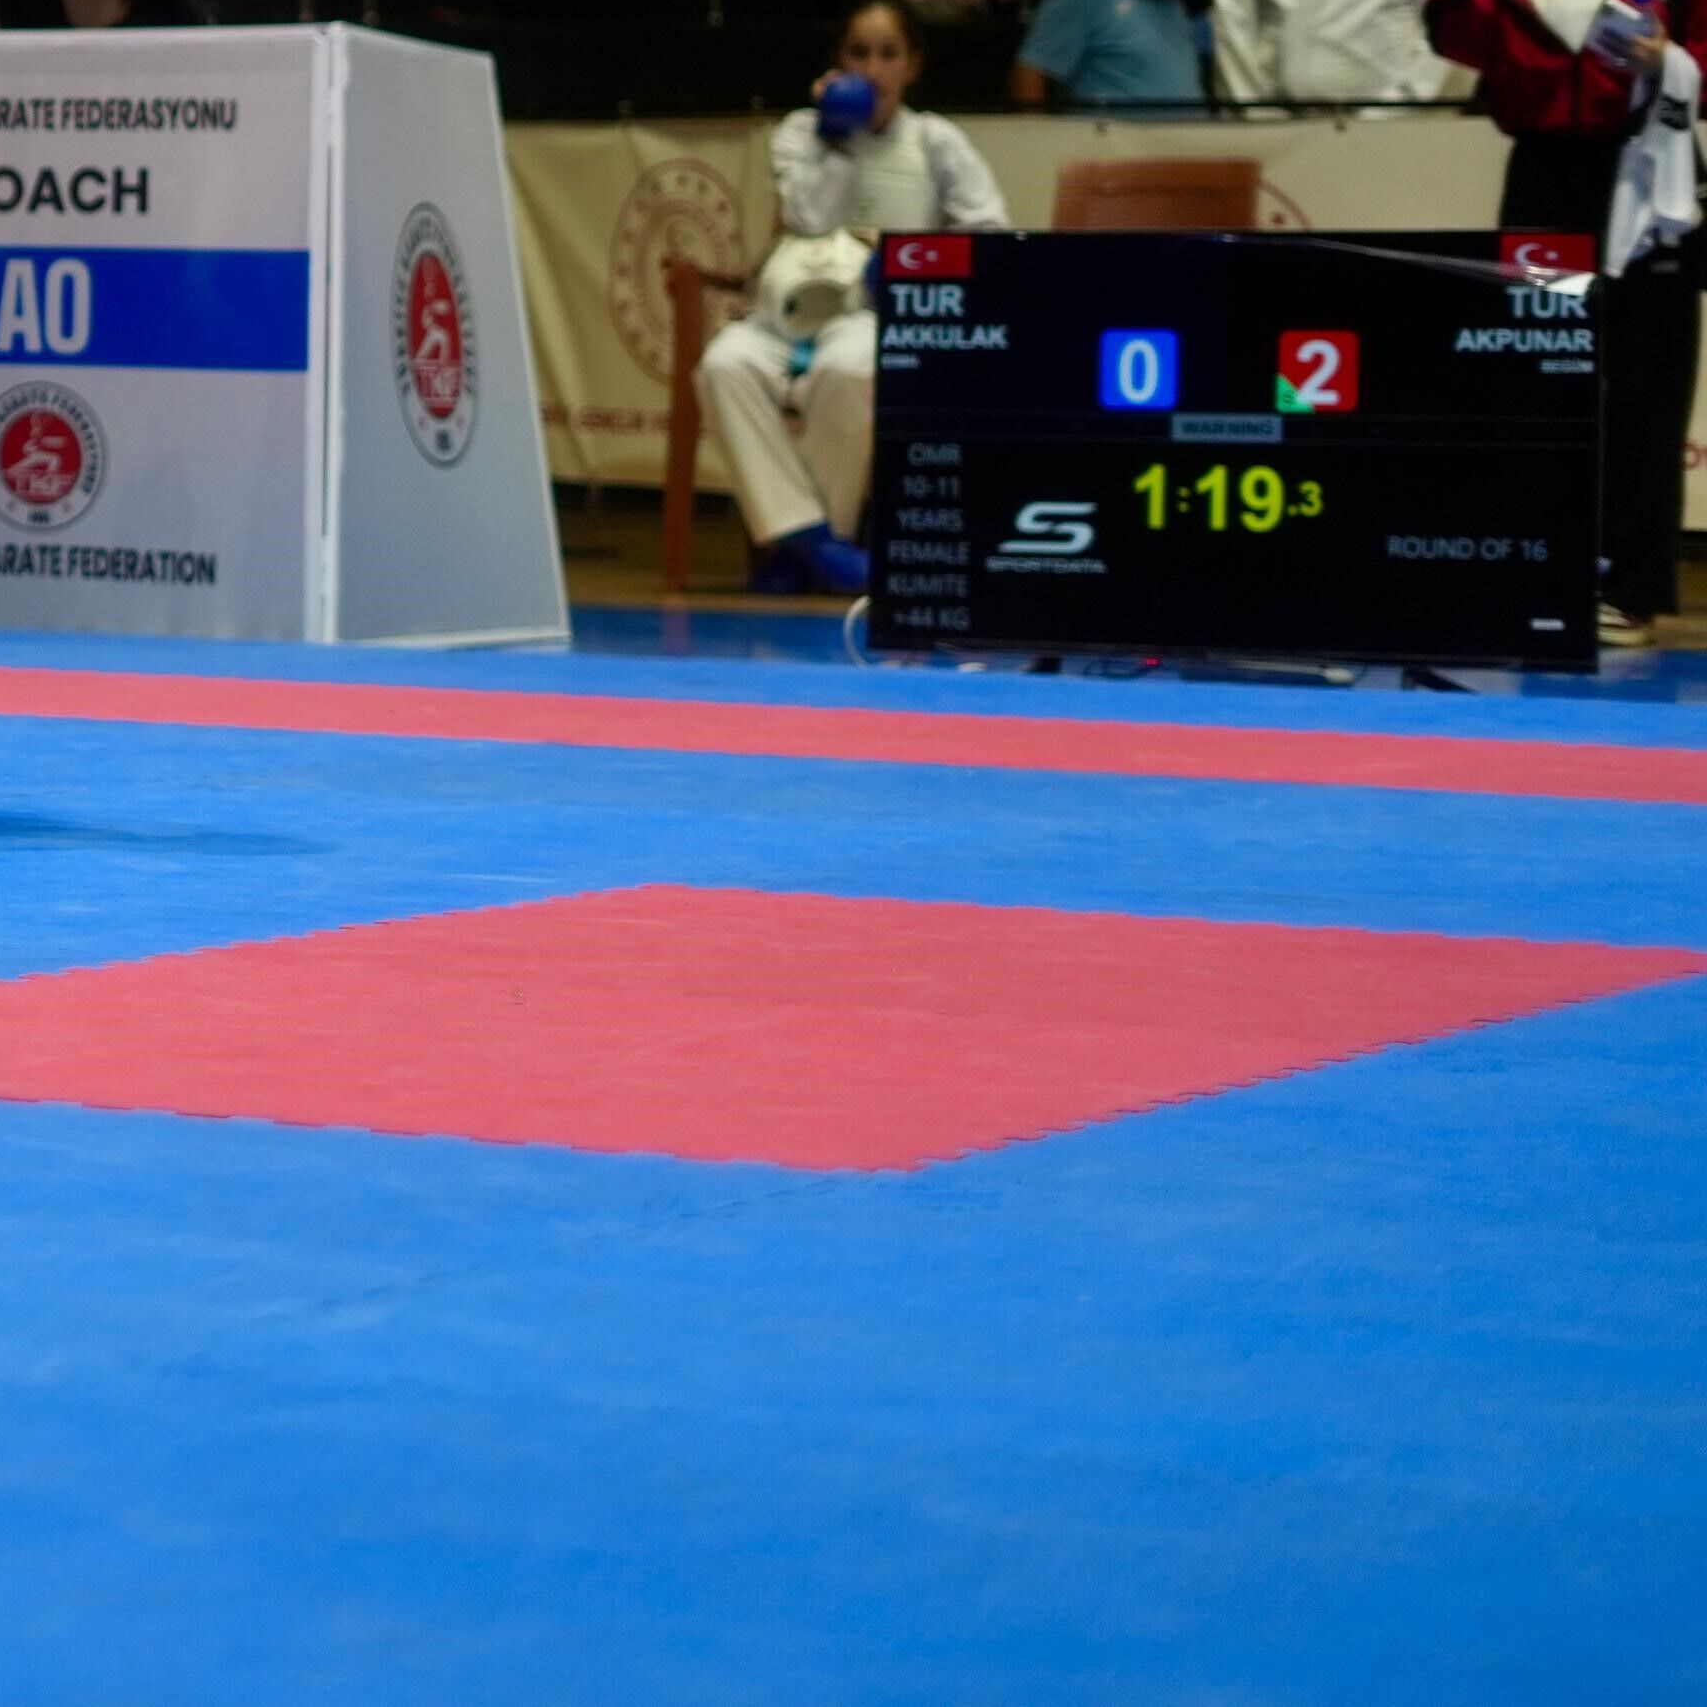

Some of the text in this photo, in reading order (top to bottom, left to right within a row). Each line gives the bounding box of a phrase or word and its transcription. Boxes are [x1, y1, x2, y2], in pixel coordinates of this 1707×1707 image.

[61, 97, 236, 131] FEDERASYONU
[887, 283, 968, 319] TUR
[1506, 284, 1589, 320] TUR
[880, 323, 1011, 351] AKKULAK
[1453, 327, 1595, 354] AKPUNAR
[1117, 337, 1159, 404] 0
[1295, 338, 1342, 407] 2
[1182, 420, 1276, 435] WARNING
[893, 507, 967, 533] YEARS
[887, 539, 971, 566] FEMALE
[1387, 535, 1549, 562] ROUND OF 16
[68, 546, 218, 585] FEDERATION
[888, 573, 971, 599] KUMITE
[937, 606, 972, 633] KG
